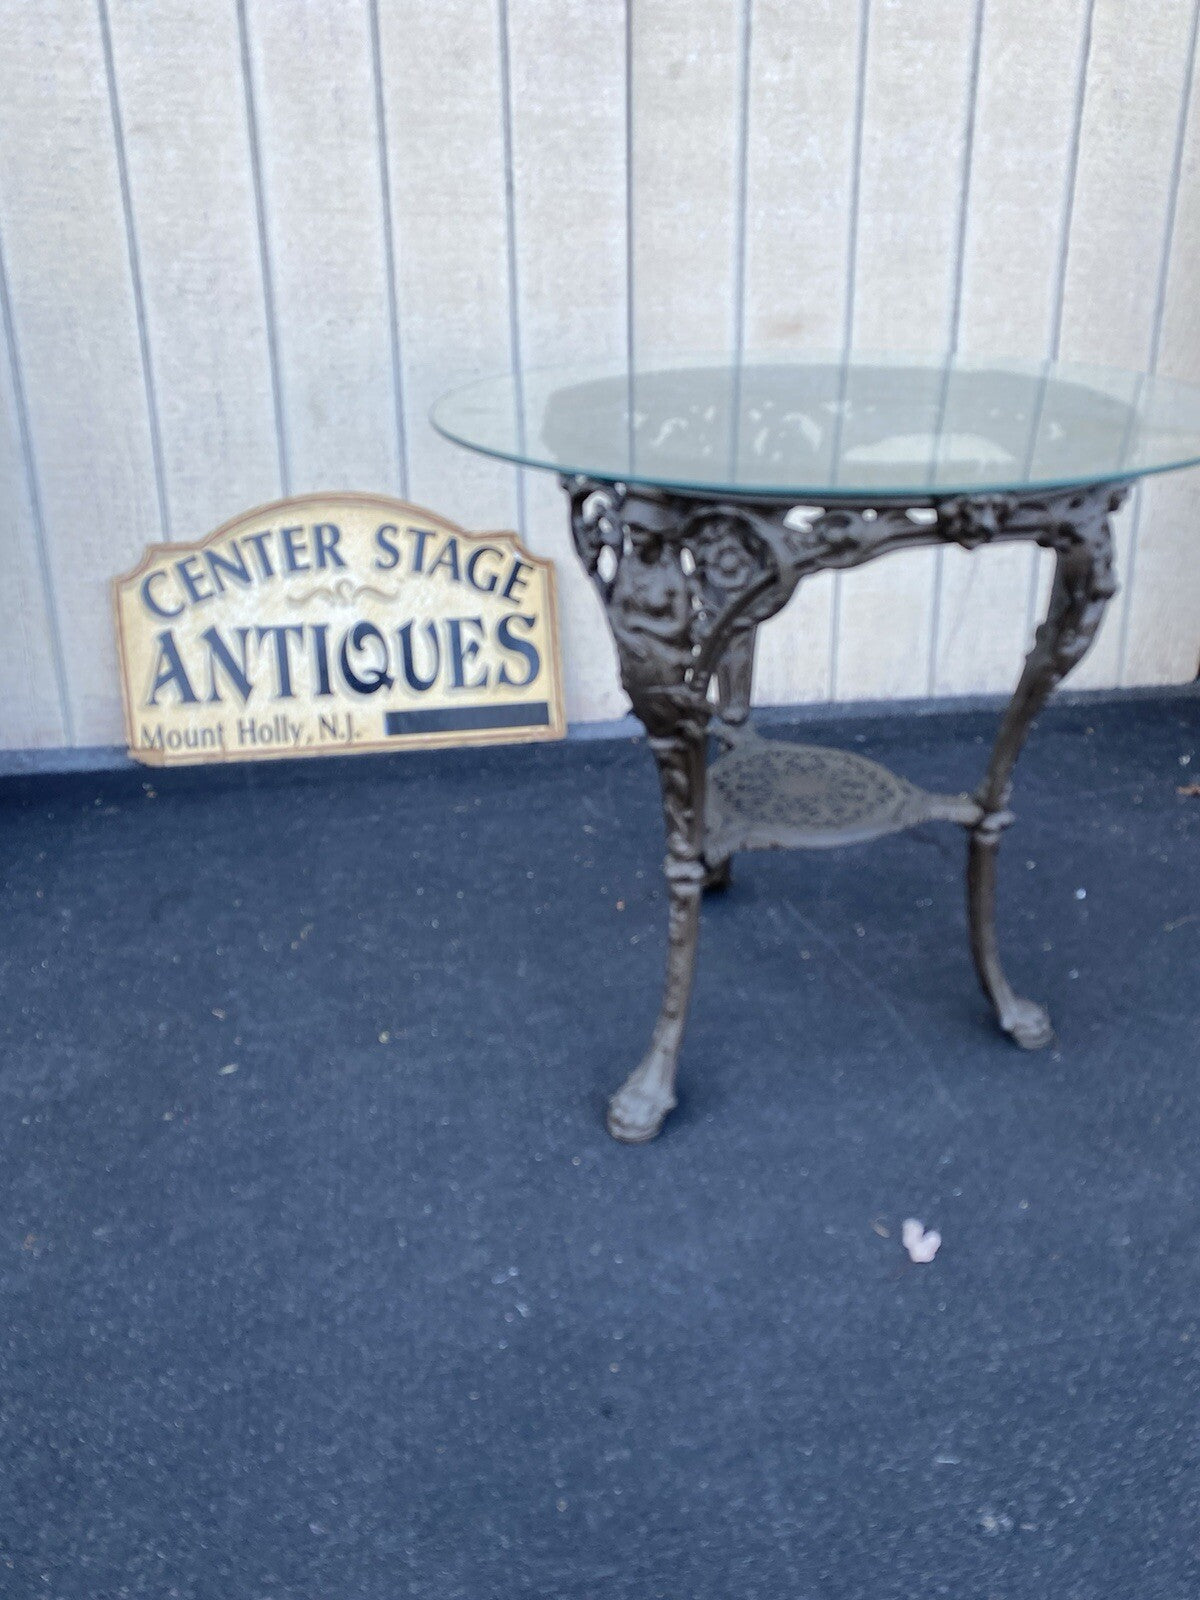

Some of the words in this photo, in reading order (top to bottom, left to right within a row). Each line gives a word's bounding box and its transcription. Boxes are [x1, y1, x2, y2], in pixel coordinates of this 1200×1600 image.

[140, 522, 348, 621] CENTER
[374, 524, 535, 605] STAGE
[143, 614, 541, 706] ANTIQUES
[141, 722, 224, 750] Mount
[238, 715, 313, 746] Holly,
[318, 713, 361, 744] N.J.
